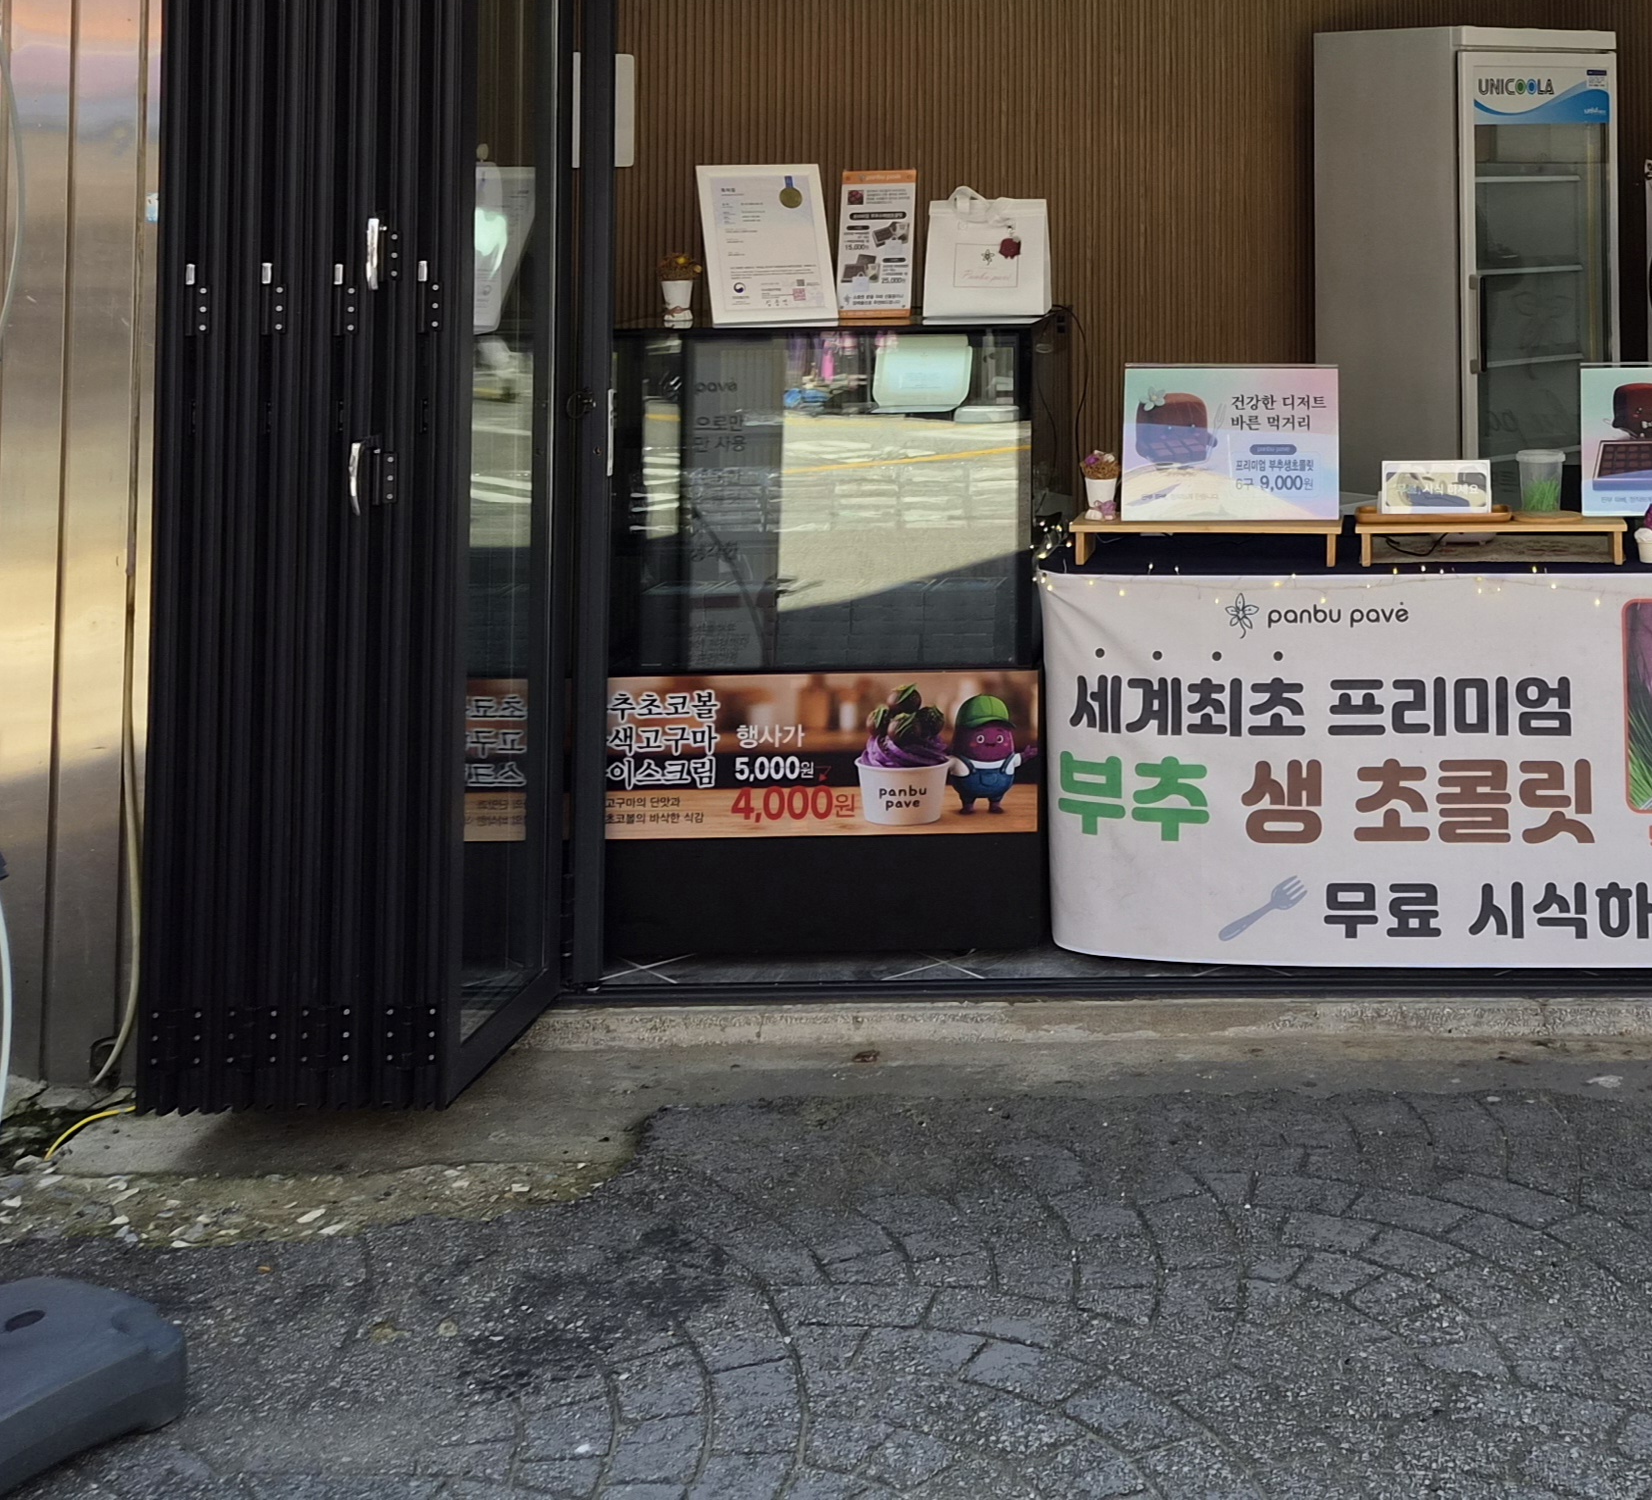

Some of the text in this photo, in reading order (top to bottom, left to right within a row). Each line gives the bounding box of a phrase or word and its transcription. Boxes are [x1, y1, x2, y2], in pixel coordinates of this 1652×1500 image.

[1230, 394, 1327, 411] 건강한 디저트
[1231, 413, 1311, 431] 바른 먹거리
[1235, 459, 1266, 471] 프리미엄
[1235, 475, 1314, 492] 6구 9,000원
[1267, 603, 1342, 628] panbu
[606, 690, 718, 722] 추초코볼
[1069, 675, 1572, 737] 세계최초 프리미엄
[606, 724, 718, 755] 색고구마
[735, 724, 806, 749] 행사가
[605, 757, 715, 789] 이스크림
[734, 756, 815, 783] 5,000원
[649, 797, 681, 808] 단맛과
[730, 786, 856, 822] 4,000원
[878, 786, 928, 800] panbu
[885, 798, 921, 811] pave
[1058, 750, 1595, 844] 부추 생 초콜릿
[649, 812, 680, 824] 바삭한
[683, 812, 705, 824] 식감
[1323, 881, 1442, 939] 무료
